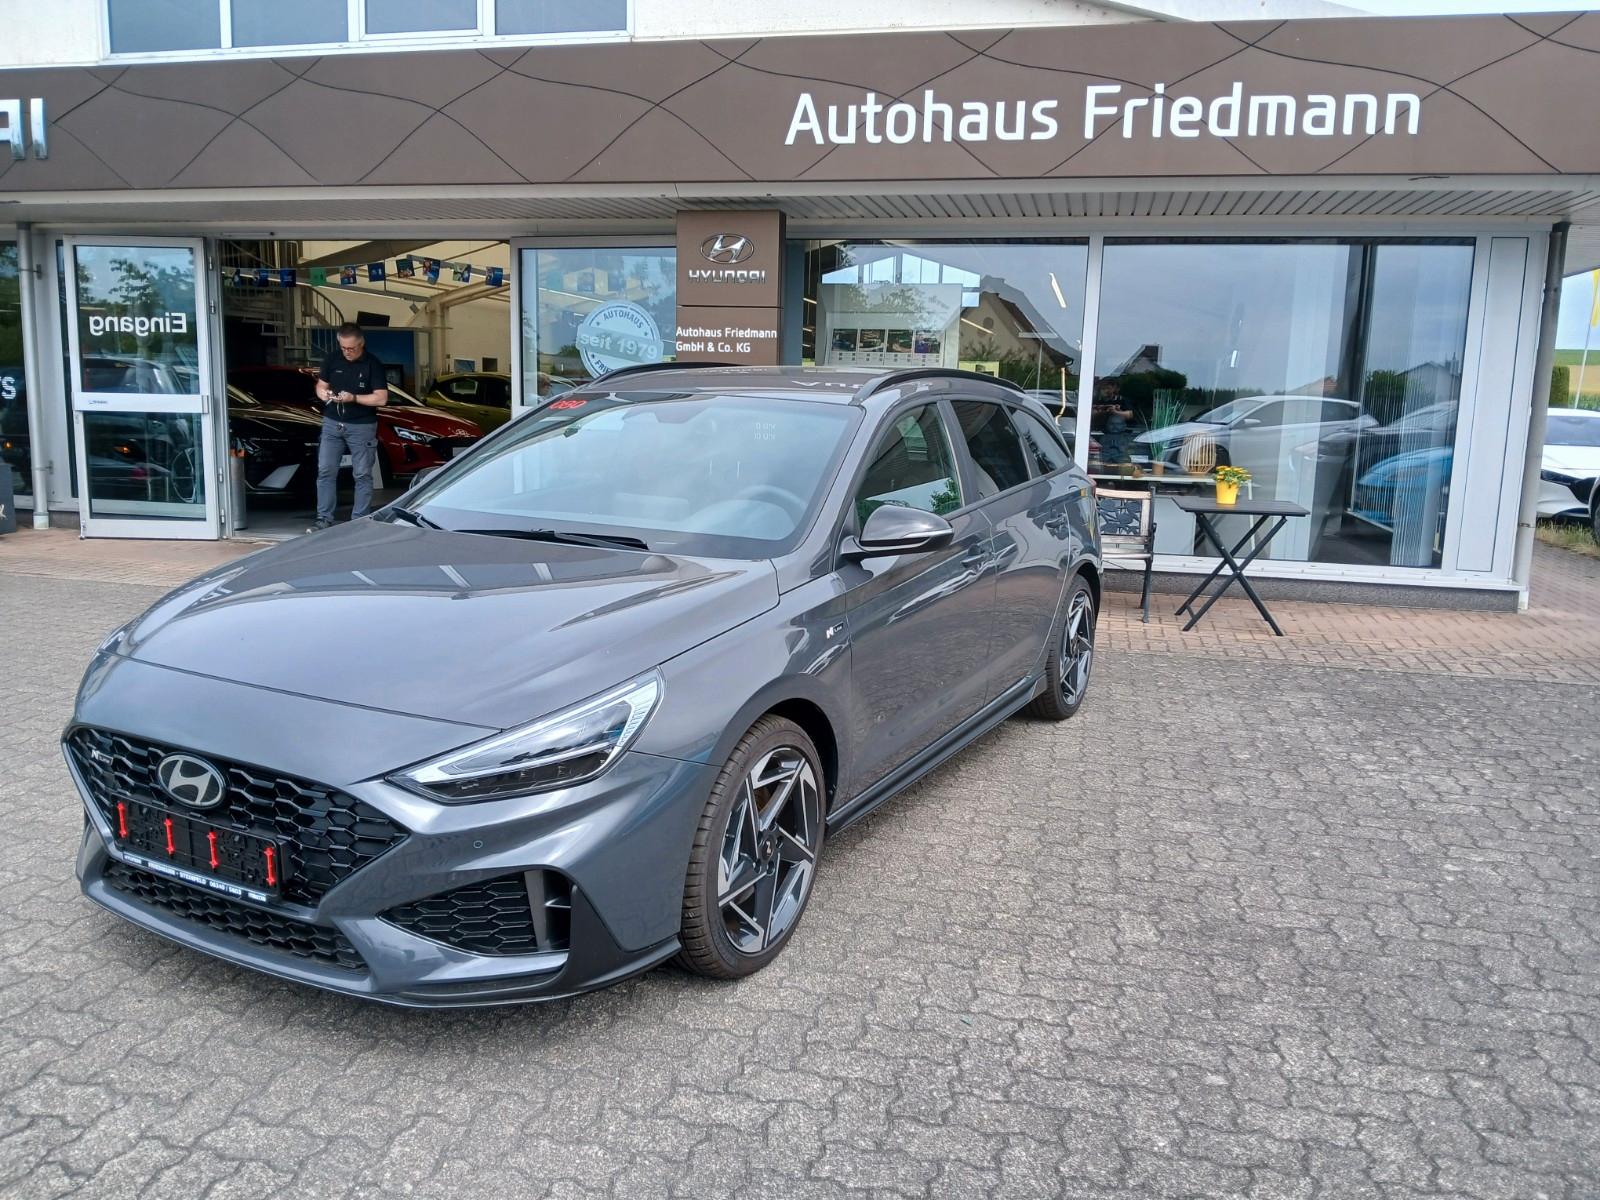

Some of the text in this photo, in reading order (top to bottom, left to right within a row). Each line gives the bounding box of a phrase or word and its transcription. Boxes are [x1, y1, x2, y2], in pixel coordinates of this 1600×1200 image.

[785, 82, 1421, 145] Autohaus Friedmann
[688, 269, 766, 284] HYUNDAI
[603, 308, 644, 329] AUTOHAUS
[675, 326, 777, 339] Autohaus Friedmann
[580, 333, 658, 360] seit 1979
[675, 341, 751, 353] GmbH & Co. KG
